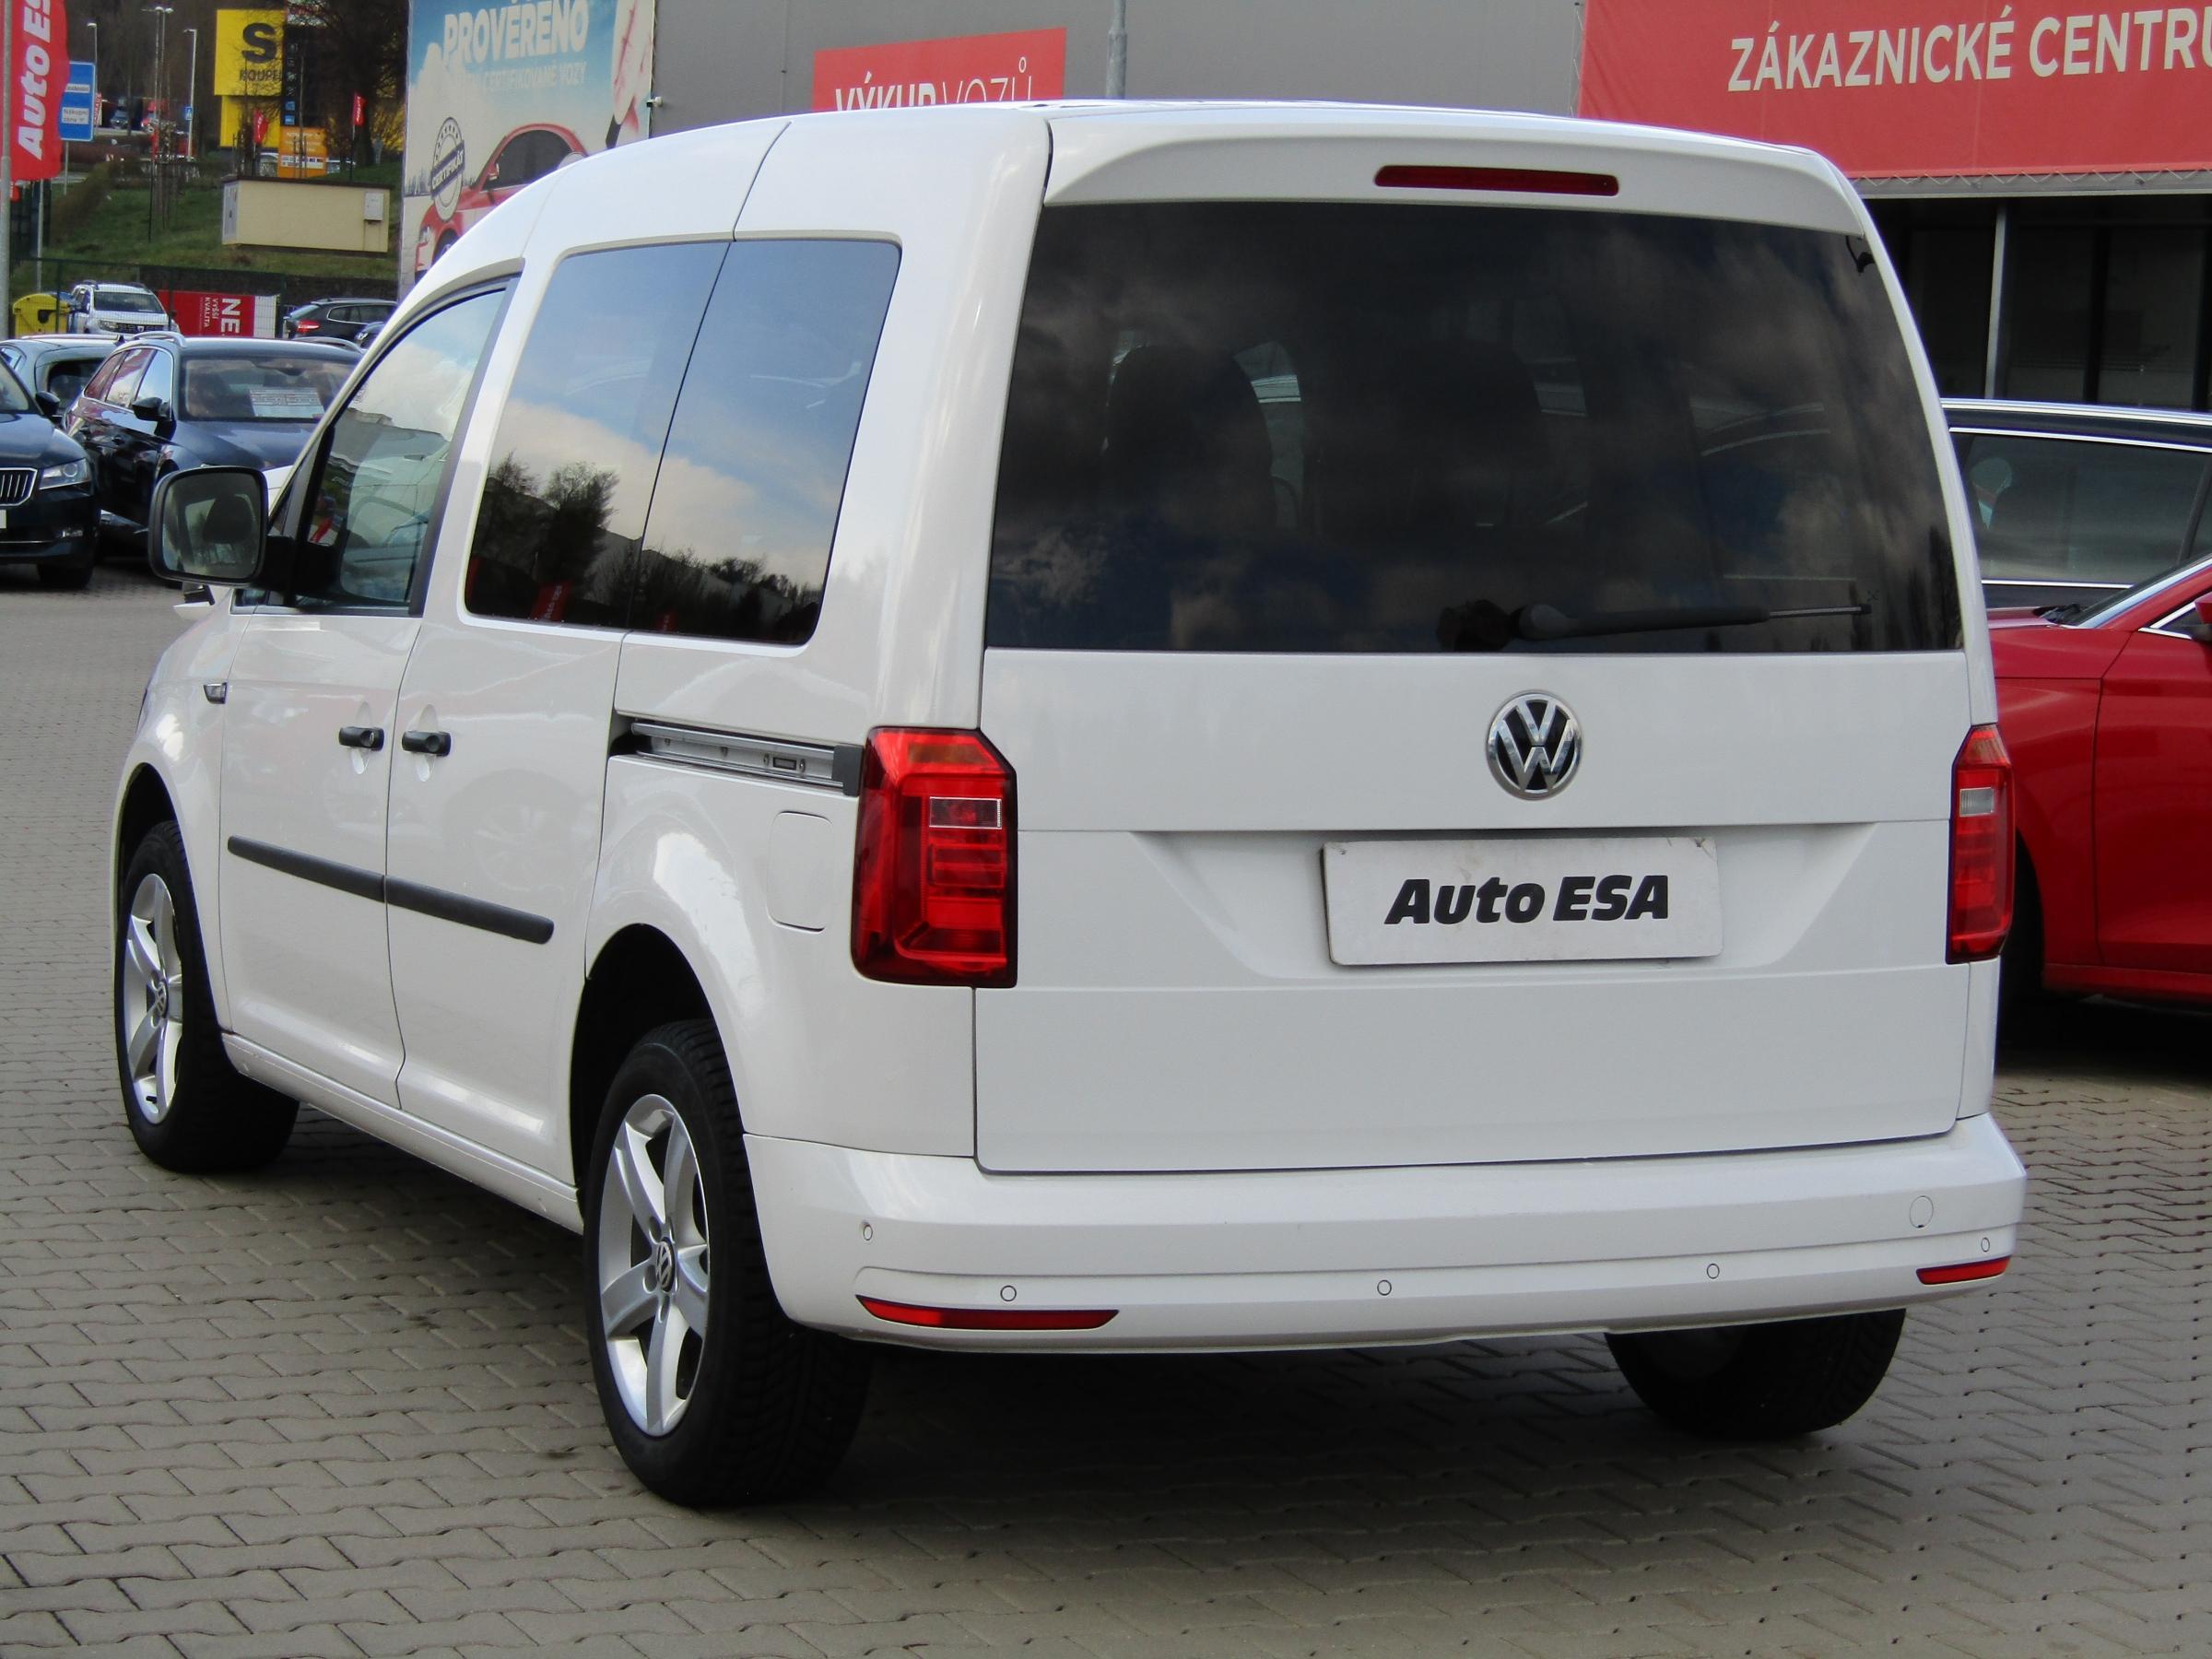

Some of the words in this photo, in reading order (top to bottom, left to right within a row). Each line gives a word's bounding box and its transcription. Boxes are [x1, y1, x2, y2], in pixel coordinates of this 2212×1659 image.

[1728, 5, 2016, 91] ZÁKAZNICKÉ
[18, 44, 51, 160] Auto
[1383, 877, 1546, 924] Auto
[1552, 875, 1668, 922] ESA
